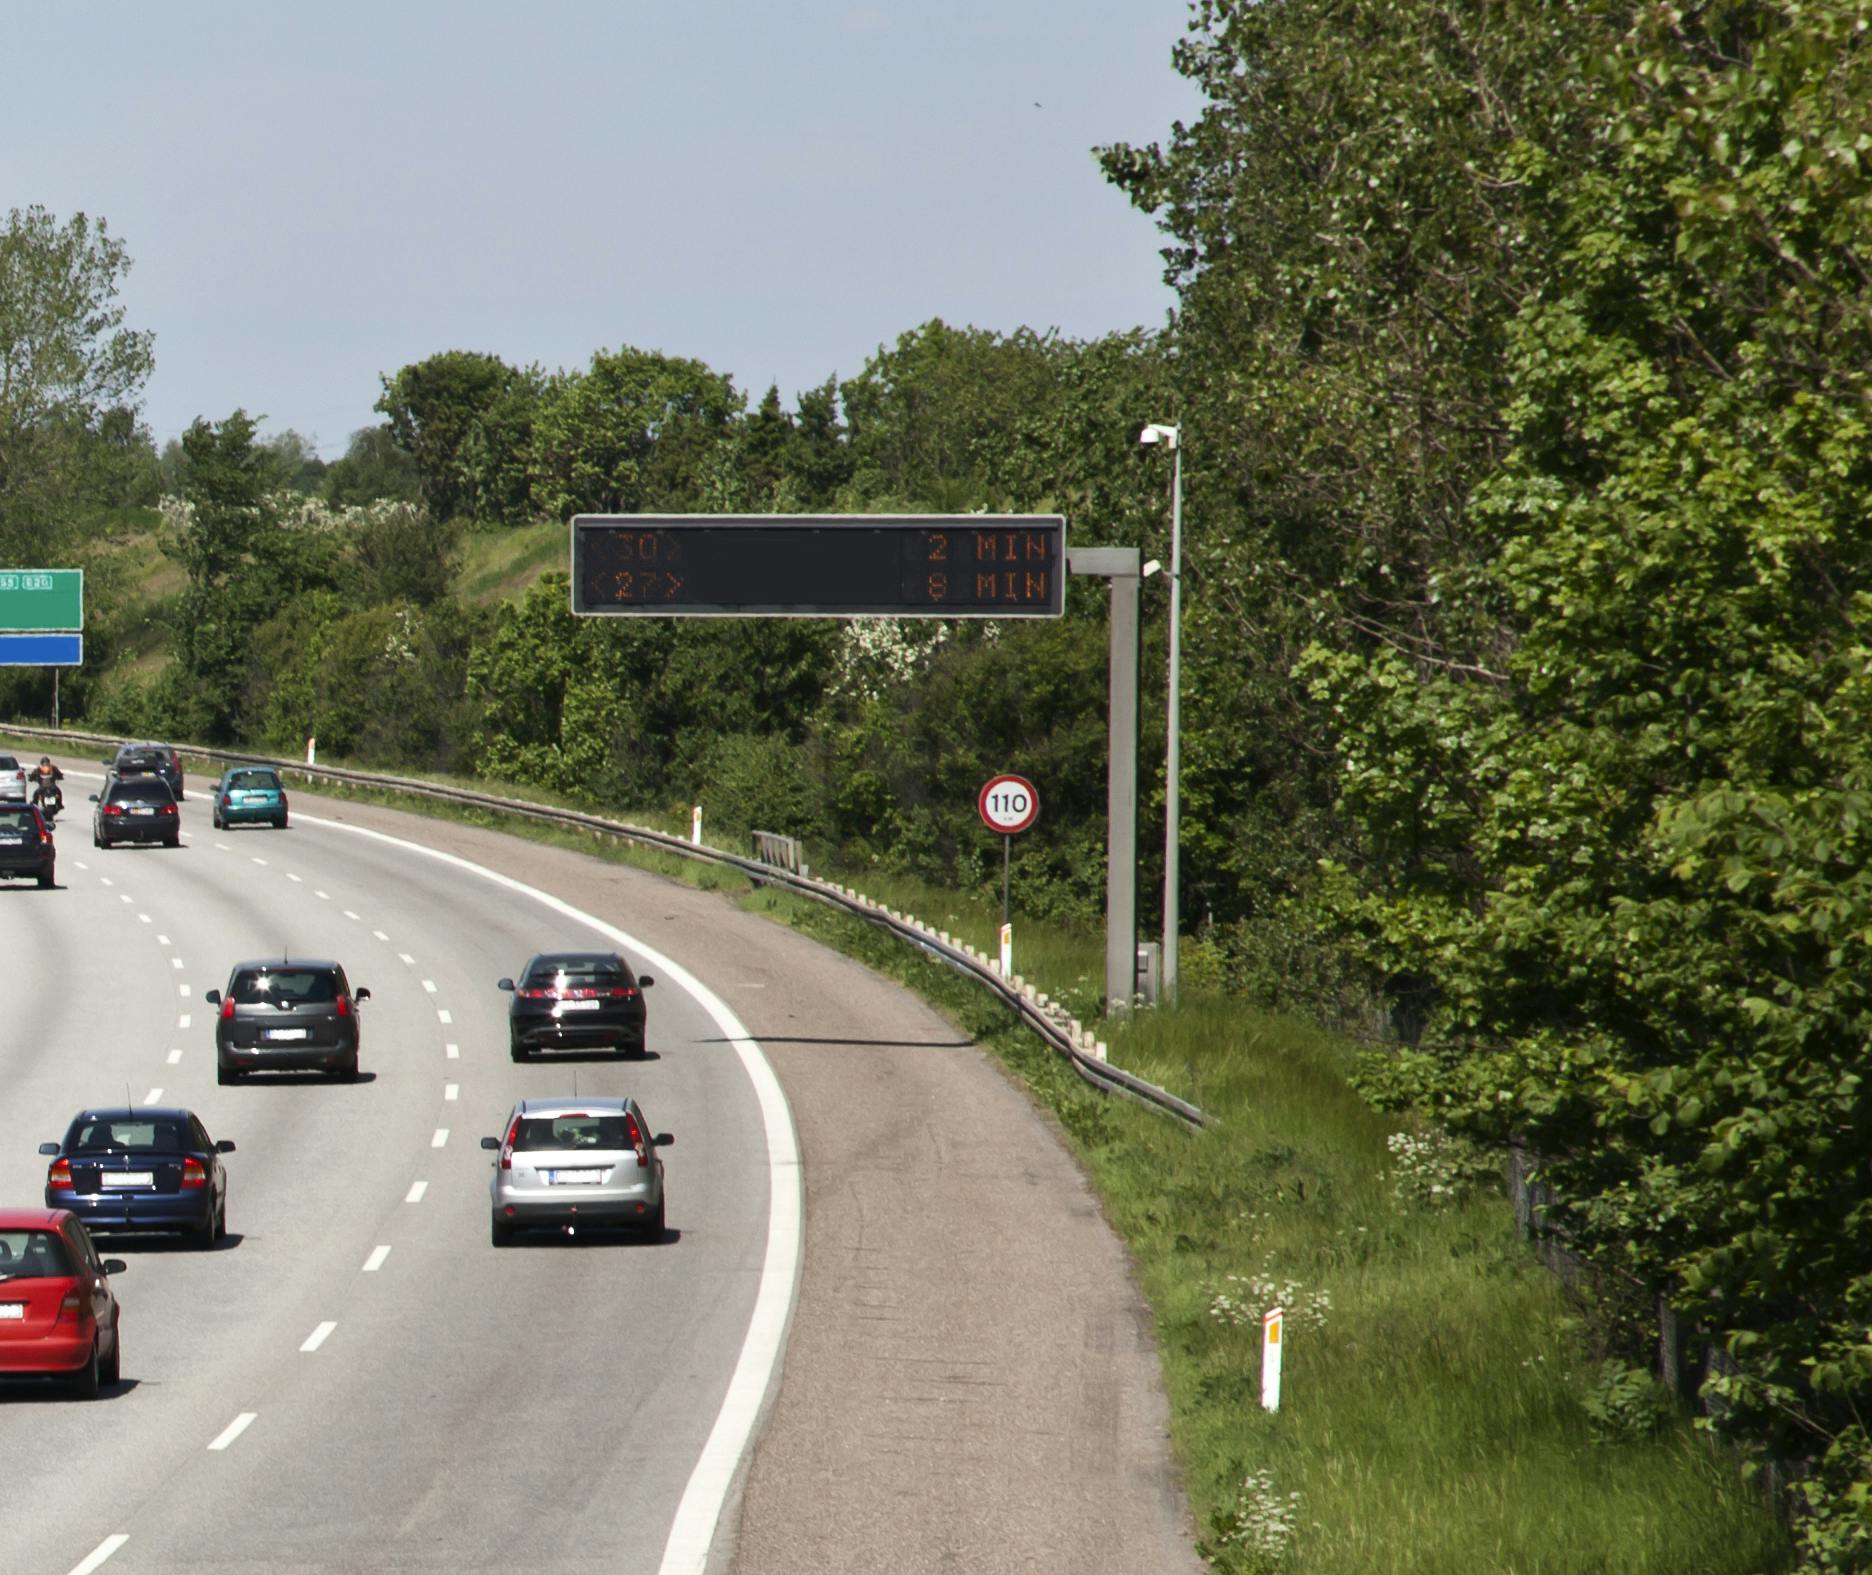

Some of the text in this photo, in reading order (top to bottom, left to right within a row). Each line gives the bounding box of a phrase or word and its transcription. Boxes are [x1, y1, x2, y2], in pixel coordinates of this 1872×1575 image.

[928, 534, 948, 560] 2
[976, 534, 1046, 560] MIN
[976, 572, 1046, 600] MIN
[991, 794, 1027, 813] 110
